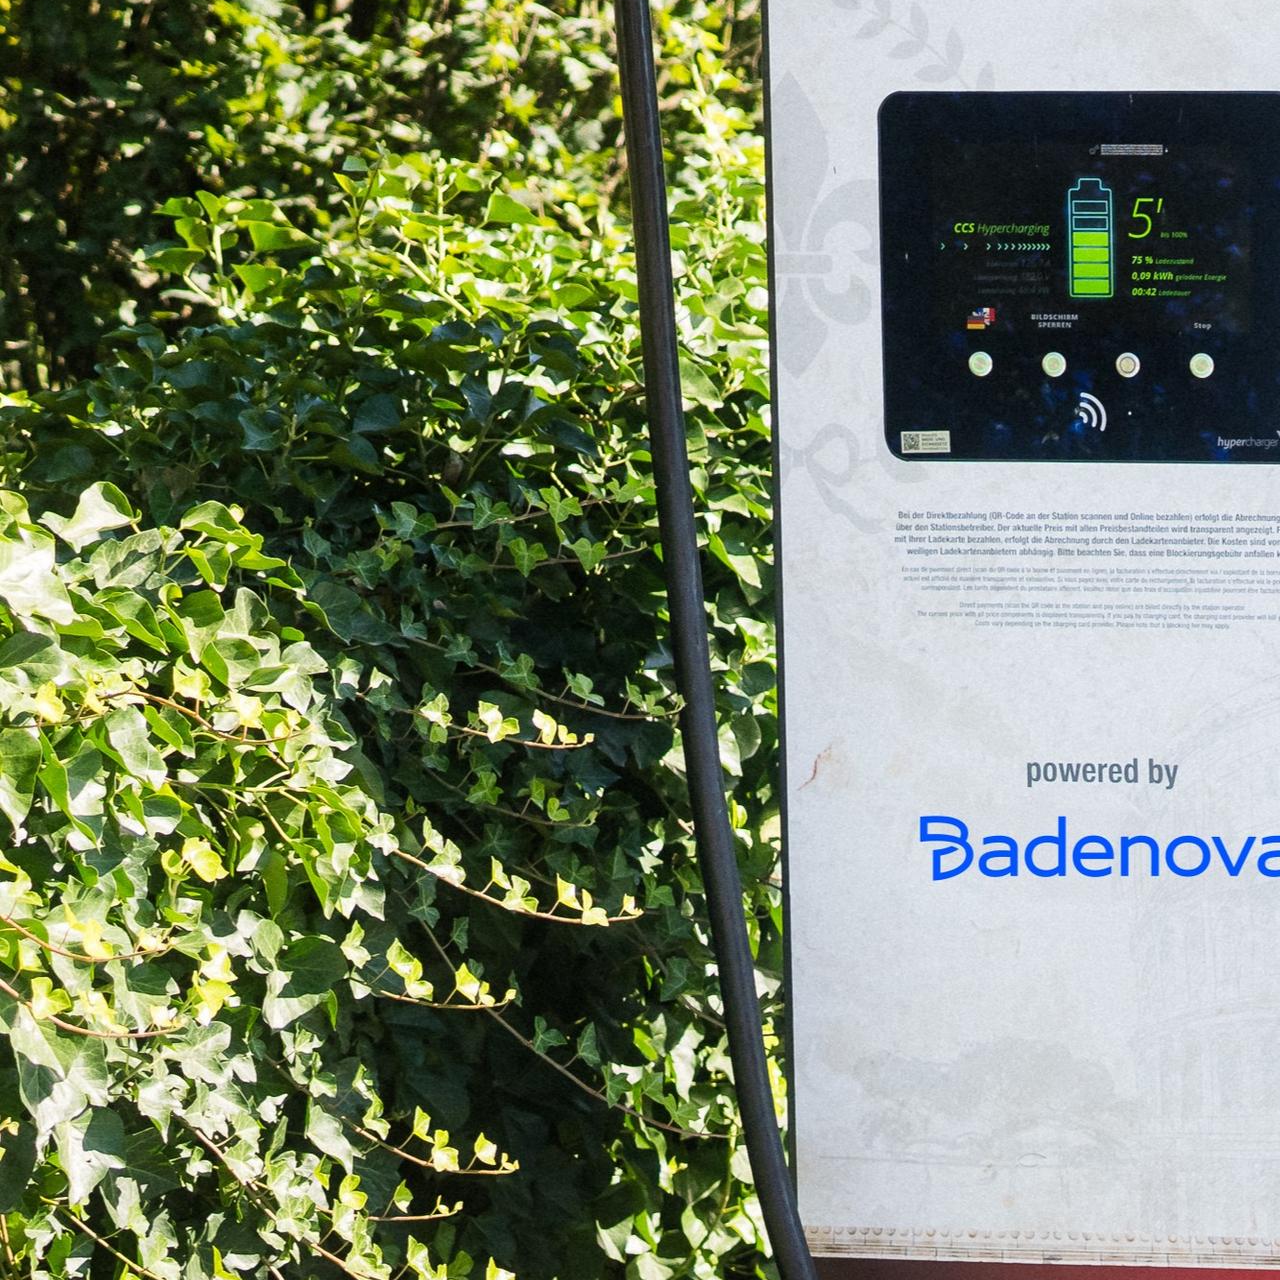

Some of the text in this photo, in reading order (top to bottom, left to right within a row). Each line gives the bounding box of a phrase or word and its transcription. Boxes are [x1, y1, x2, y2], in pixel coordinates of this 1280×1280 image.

[954, 222, 1050, 237] CCS Hypercharging
[1131, 256, 1143, 265] 75
[1131, 272, 1151, 281] 0,09
[1153, 271, 1174, 280] kWh
[1131, 287, 1157, 297] 00:42
[1038, 321, 1072, 329] SPERREN
[1193, 322, 1212, 330] Stop
[1217, 436, 1278, 450] hypercharger
[898, 511, 911, 519] Bei
[926, 512, 987, 521] Direktbezahlung
[1037, 512, 1050, 520] der
[1235, 514, 1280, 522] Abrechnung
[997, 524, 1010, 532] Der
[1065, 525, 1077, 533] mit
[1079, 525, 1098, 533] allen
[1100, 525, 1169, 533] Preisbestandteilen
[1190, 526, 1234, 535] transparent
[1004, 536, 1029, 546] erfolgt
[1031, 536, 1042, 544] die
[1044, 537, 1090, 546] Abrechnung
[1115, 537, 1129, 545] den
[1129, 549, 1147, 557] dass
[1149, 549, 1165, 557] eine
[1244, 550, 1274, 558] anfallen
[1026, 758, 1179, 790] powered by
